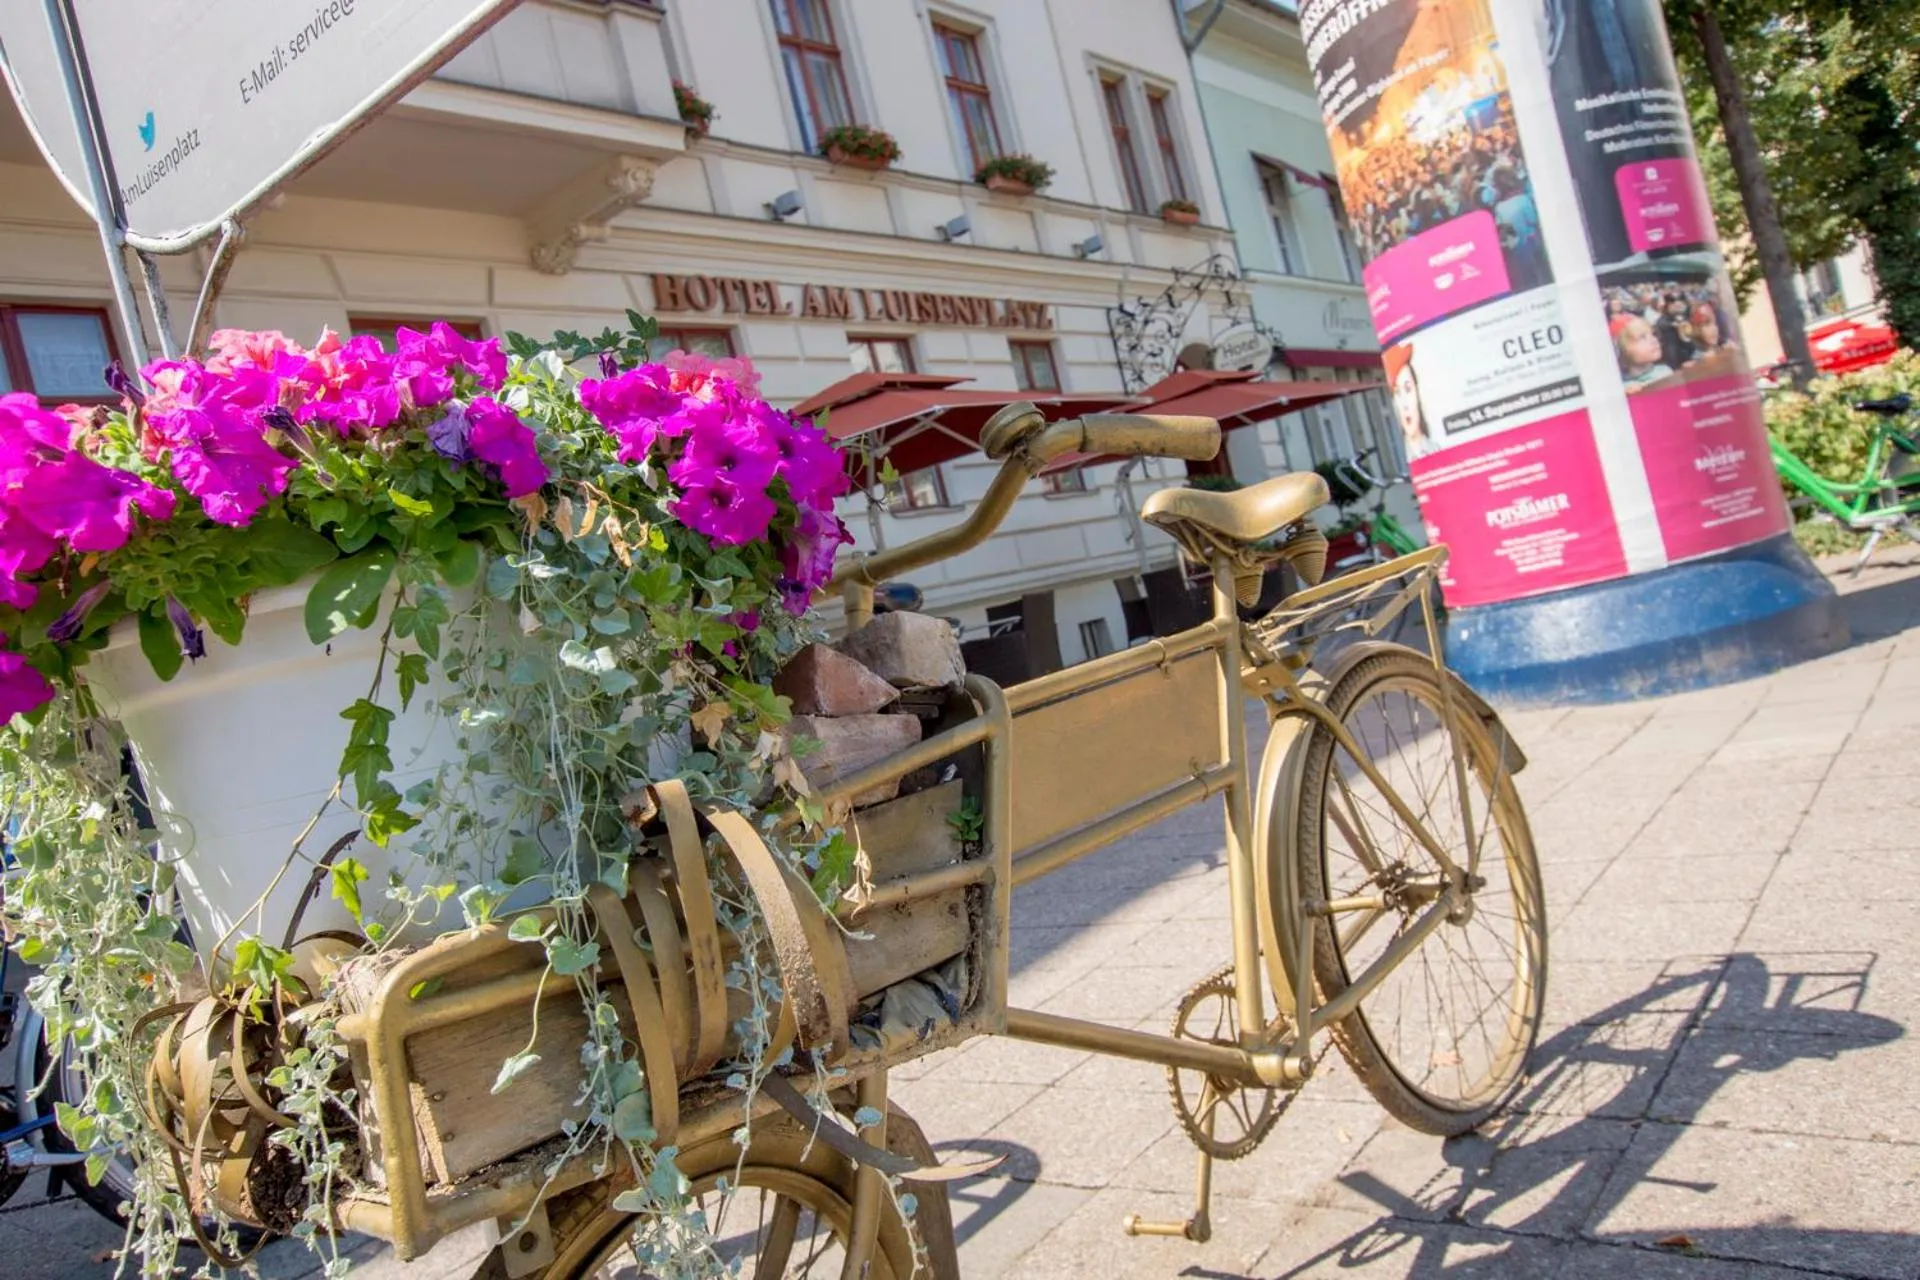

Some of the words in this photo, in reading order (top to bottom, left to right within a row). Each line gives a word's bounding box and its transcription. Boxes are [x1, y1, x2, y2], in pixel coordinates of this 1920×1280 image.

[239, 50, 288, 105] E-Mail:
[652, 272, 795, 316] HOTEL
[801, 283, 855, 319] AM
[860, 287, 1055, 331] LUISENPLATZ
[1502, 324, 1564, 360] CLEO
